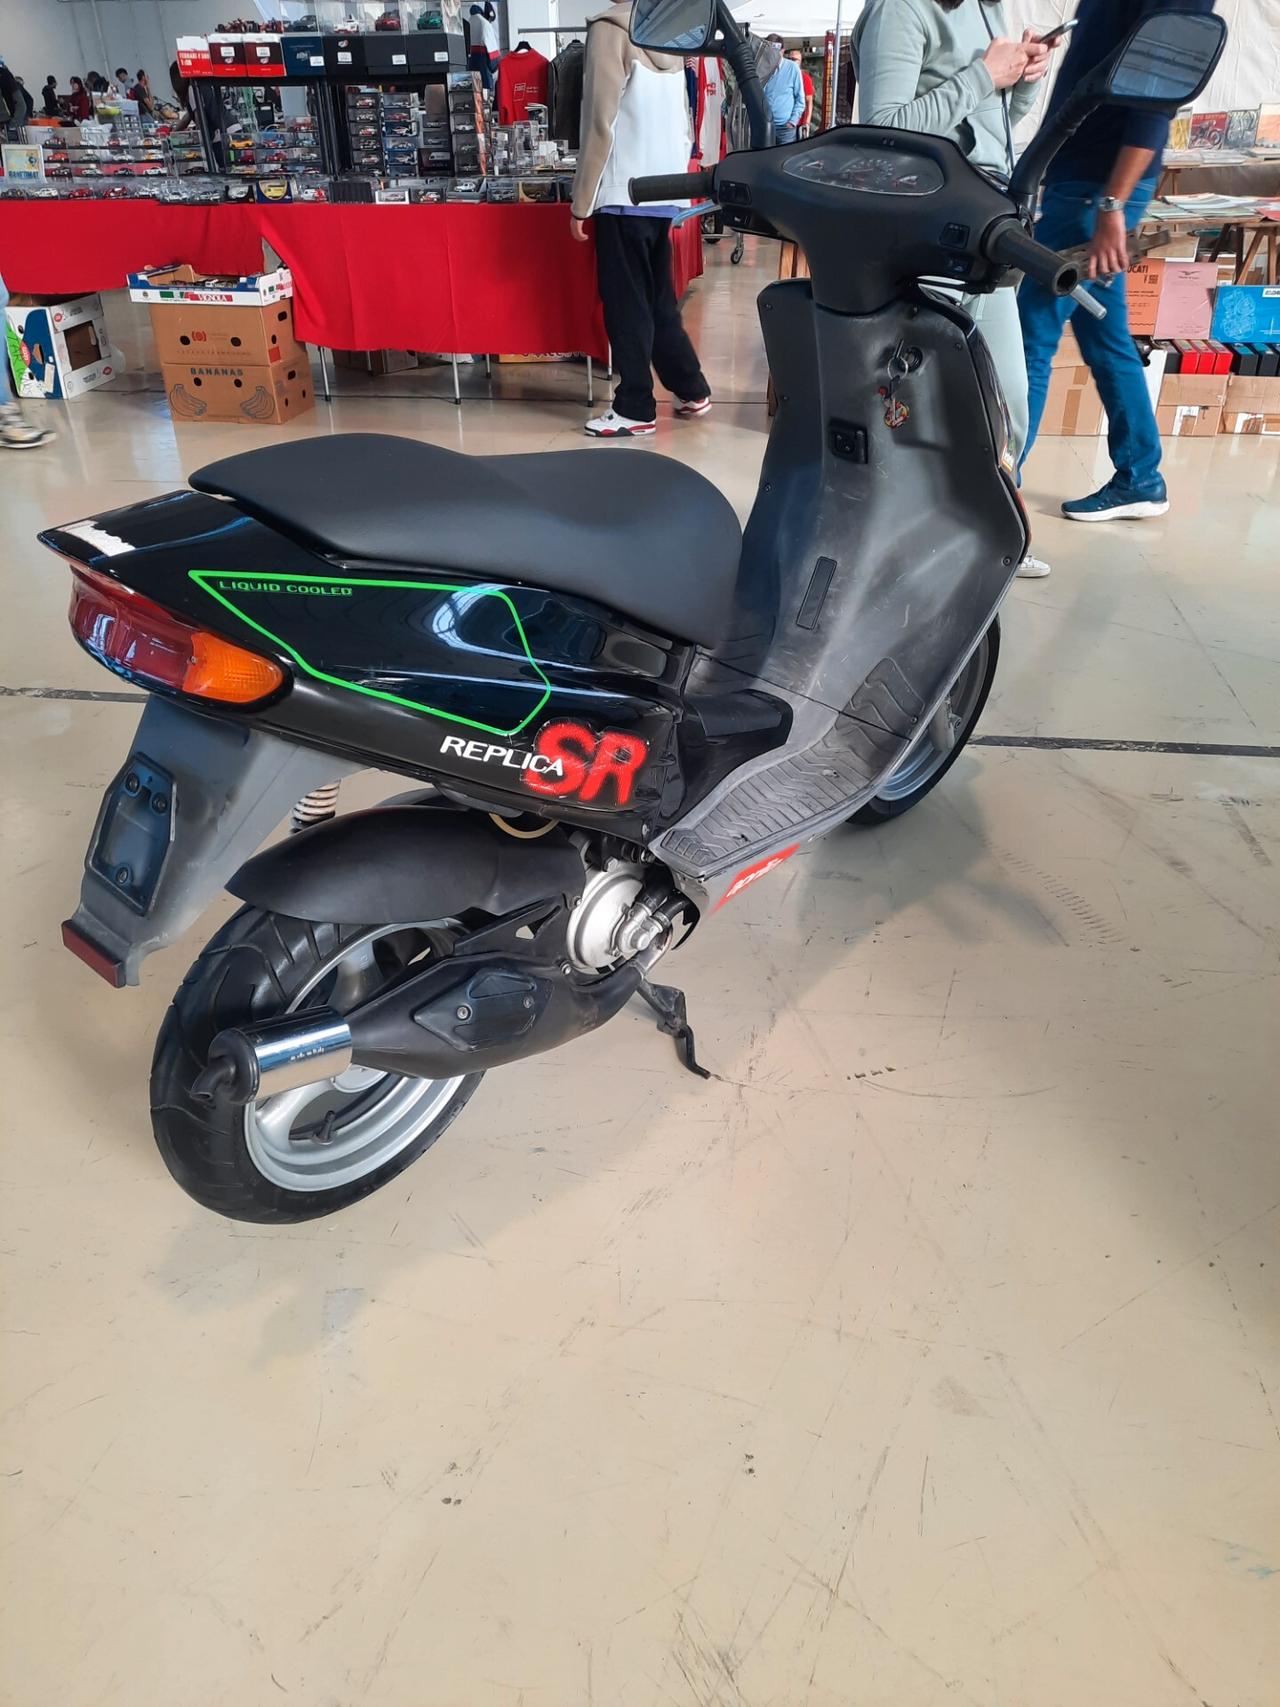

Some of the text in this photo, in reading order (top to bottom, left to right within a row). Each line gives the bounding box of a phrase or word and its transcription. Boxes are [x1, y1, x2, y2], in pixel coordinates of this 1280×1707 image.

[1123, 264, 1149, 274] UCATI
[190, 367, 244, 377] BANANAS
[219, 580, 353, 596] LIQUID COOLED
[439, 735, 564, 777] REPLICA
[523, 722, 648, 805] SR
